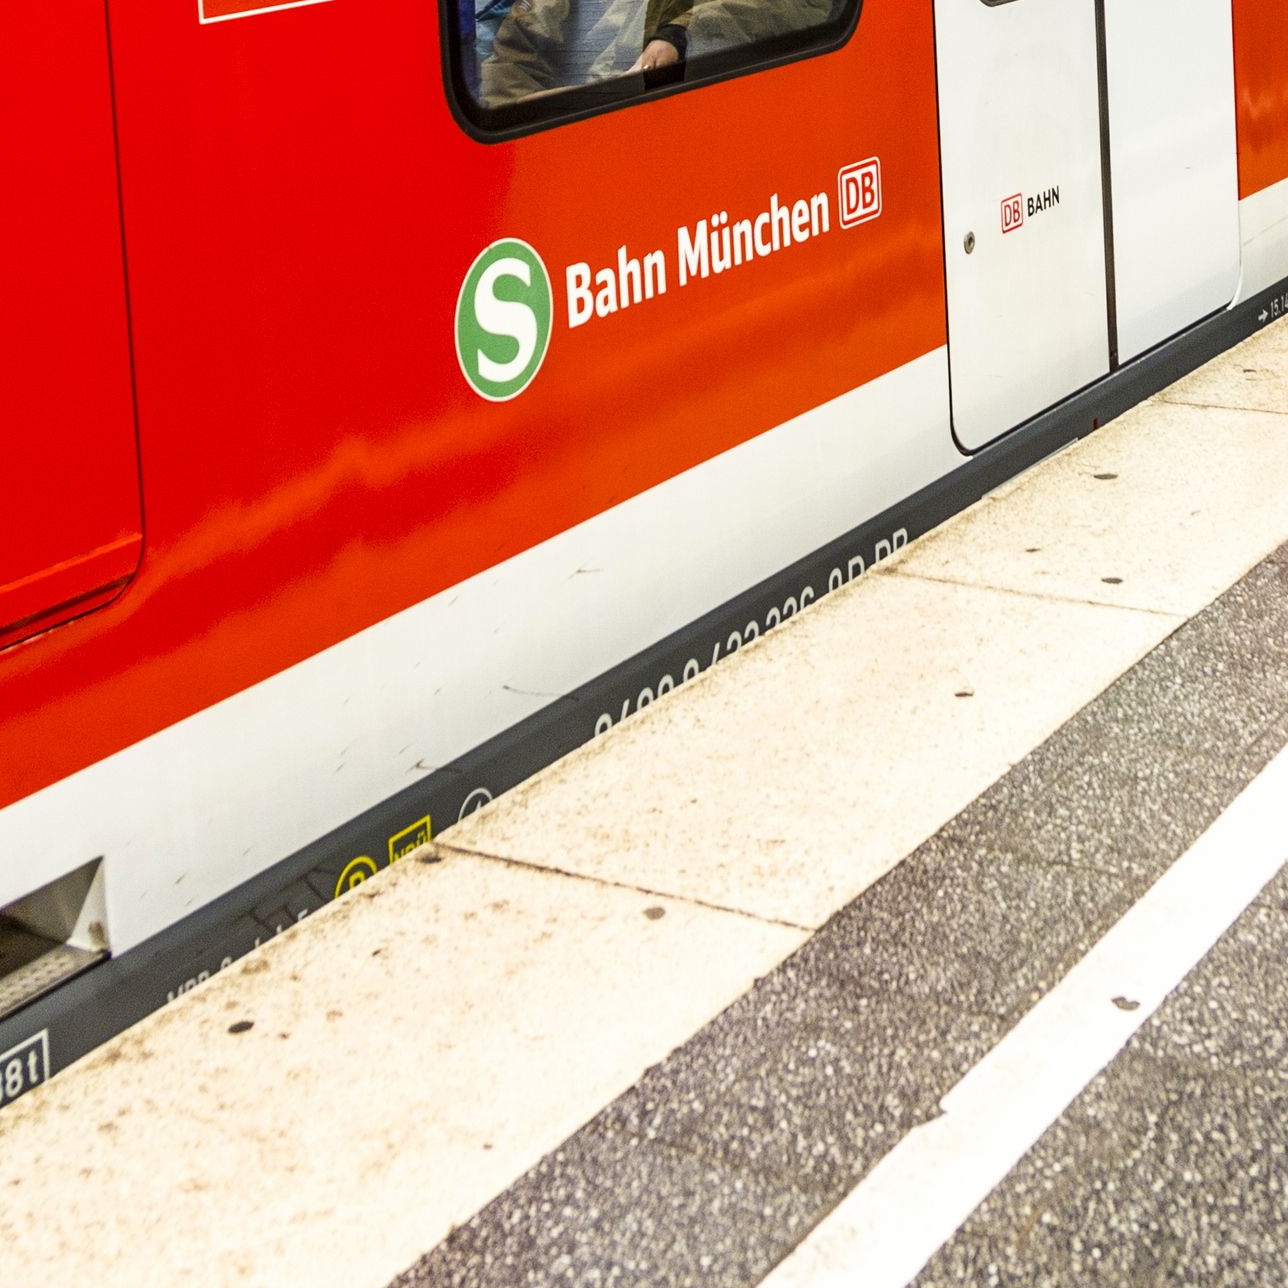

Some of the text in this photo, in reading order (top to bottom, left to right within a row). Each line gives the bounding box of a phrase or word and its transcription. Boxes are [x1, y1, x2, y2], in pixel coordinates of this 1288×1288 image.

[1003, 185, 1060, 228] DB BAHN
[472, 168, 877, 385] S Bahn München DB
